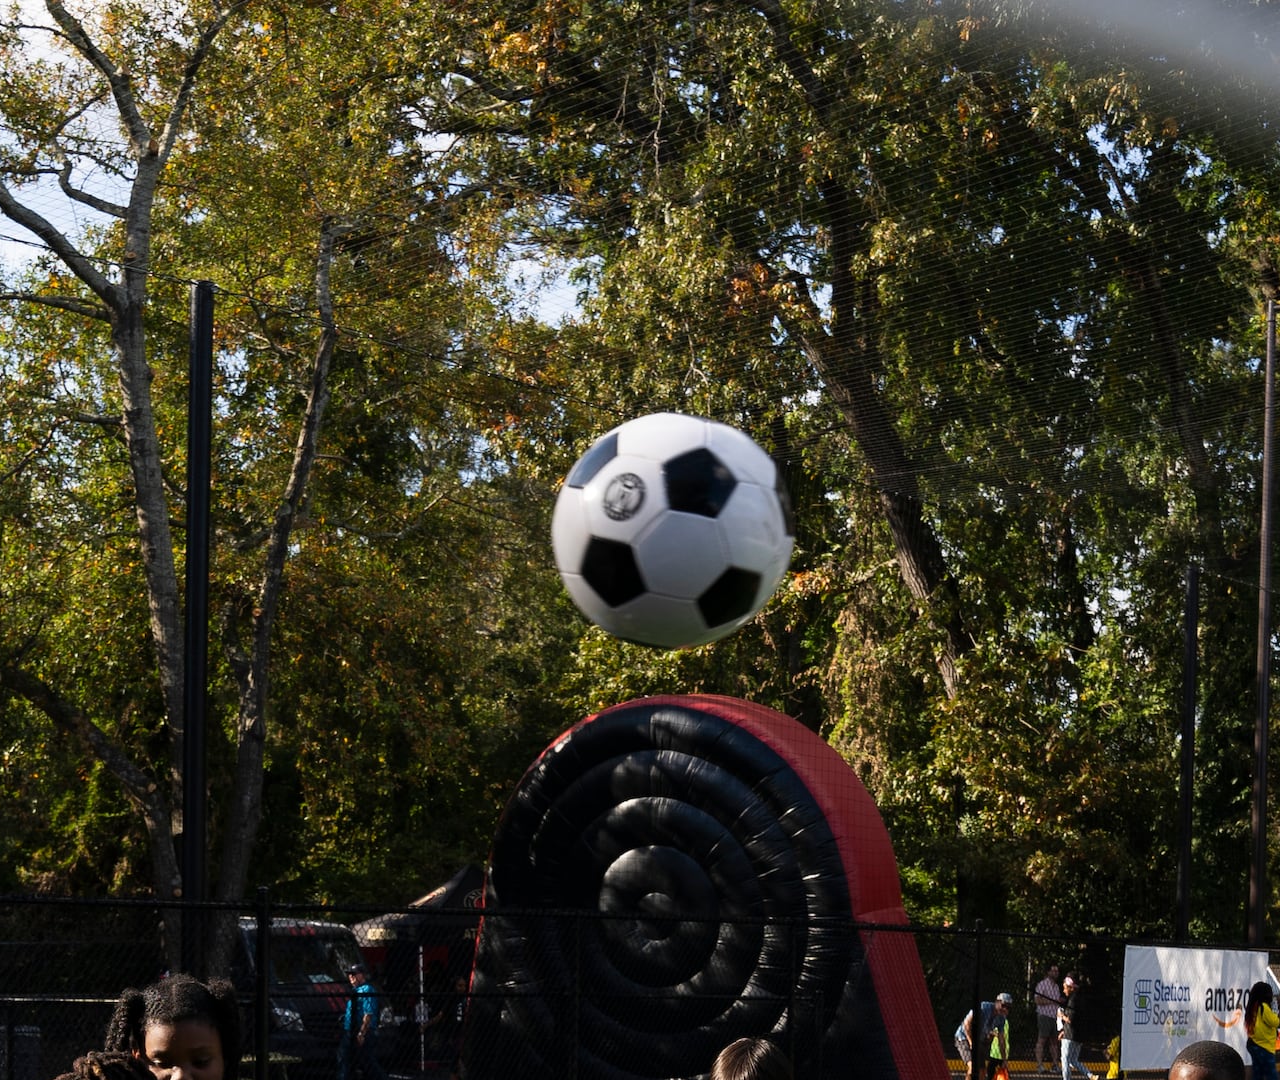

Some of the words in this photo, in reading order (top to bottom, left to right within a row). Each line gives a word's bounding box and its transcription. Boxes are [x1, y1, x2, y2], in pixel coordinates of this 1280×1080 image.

[1153, 979, 1191, 1002] Station
[1205, 986, 1251, 1013] amazo
[1152, 1004, 1190, 1026] Soccer
